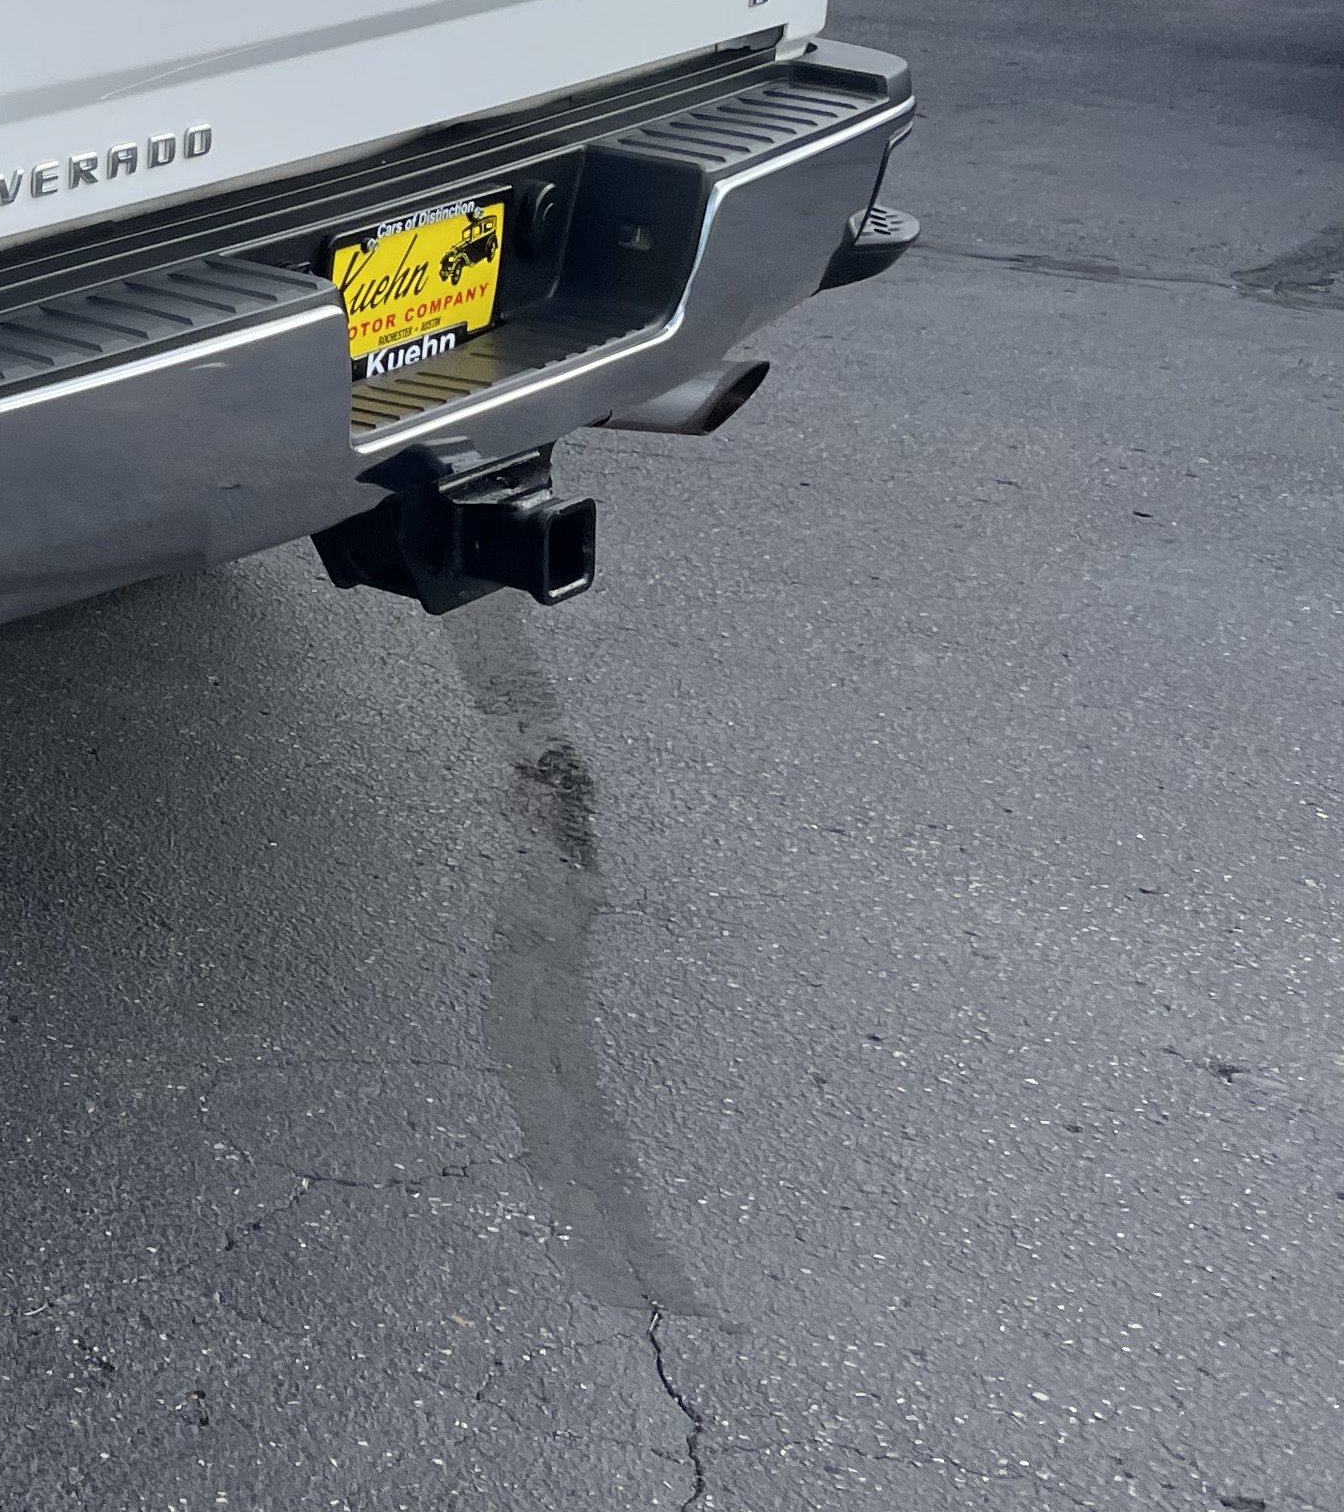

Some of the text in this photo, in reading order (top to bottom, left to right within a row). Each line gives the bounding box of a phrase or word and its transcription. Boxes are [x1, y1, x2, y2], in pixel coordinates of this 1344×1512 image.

[376, 200, 475, 238] Cars of Distinction
[338, 233, 430, 317] Kuehn
[348, 282, 489, 343] OTOR COMPANY
[378, 325, 414, 346] ROCHESTER
[365, 332, 456, 380] Kuehn
